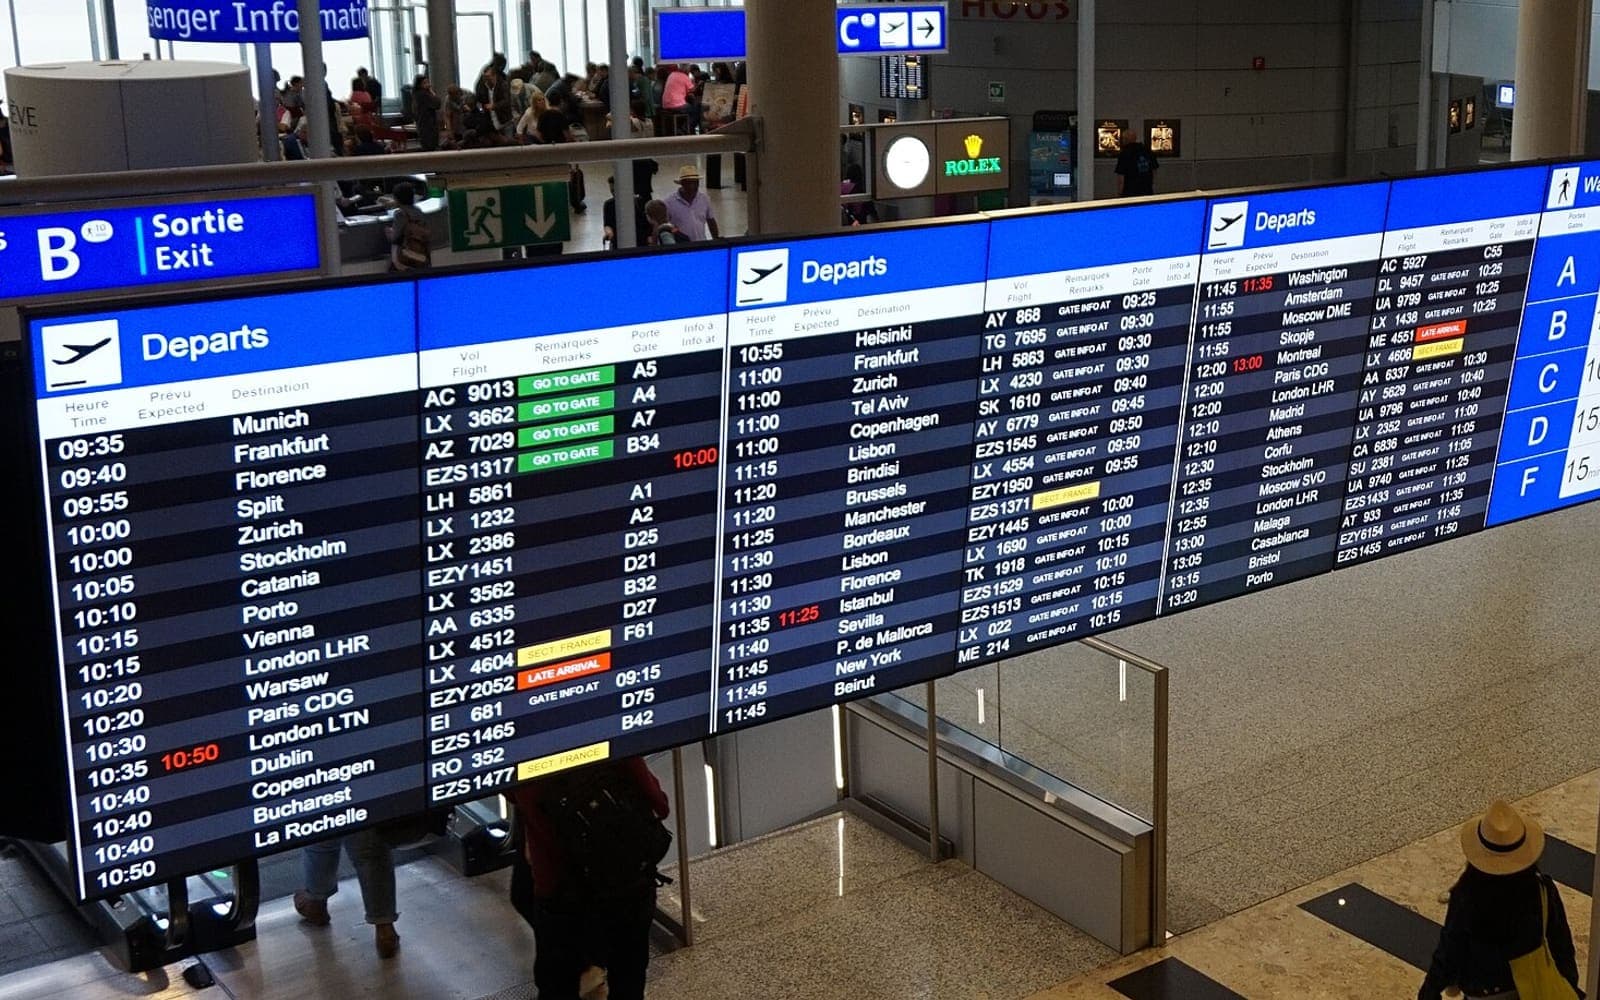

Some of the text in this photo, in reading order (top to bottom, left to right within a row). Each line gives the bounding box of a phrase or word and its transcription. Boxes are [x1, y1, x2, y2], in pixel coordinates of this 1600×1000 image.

[840, 15, 860, 47] C
[945, 157, 1001, 176] ROLEX
[152, 208, 244, 238] Sortie
[1255, 208, 1316, 233] Departs
[37, 227, 81, 281] B
[155, 243, 214, 271] Exit
[1483, 245, 1503, 259] C55
[801, 255, 887, 285] Departs
[1380, 255, 1428, 273] AC 5927
[1478, 262, 1503, 277] 10:25
[1556, 256, 1577, 287] A
[1207, 276, 1273, 298] 11:45 11:35
[1288, 268, 1348, 286] Washington
[1378, 274, 1425, 292] DL 9457
[1123, 292, 1156, 309] 09:25
[1284, 287, 1343, 306] Amsterdam
[857, 303, 911, 318] Destination
[985, 307, 1041, 328] AY 868
[1058, 304, 1081, 316] GATE
[631, 328, 660, 340] Porte
[856, 325, 912, 347] Helsinki
[1548, 310, 1568, 341] B
[142, 324, 270, 362] Departs
[534, 336, 600, 353] Remarques
[633, 342, 658, 353] Gate
[985, 328, 1047, 350] TG 7695
[460, 351, 480, 361] Vol
[542, 351, 592, 366] Remarks
[740, 343, 783, 363] 10:55
[854, 348, 919, 371] Frankfurt
[983, 350, 1044, 372] LH 5863
[1277, 345, 1322, 365] Montreal
[452, 364, 488, 378] Flight
[632, 360, 657, 379] A5
[739, 367, 782, 387] 11:00
[1197, 355, 1263, 378] 12:00 13:00
[1538, 362, 1559, 394] C
[231, 380, 309, 400] Destination
[533, 371, 601, 390] GO TO GATE
[852, 373, 897, 393] Zurich
[1114, 375, 1147, 393] 09:40
[424, 380, 515, 408] AC 9013
[632, 385, 656, 404] A4
[851, 394, 909, 416] Tel Aviv
[979, 393, 1041, 415] SK 1610
[65, 399, 110, 413] Heure
[137, 402, 205, 421] Expected
[1269, 403, 1305, 422] Madrid
[71, 414, 107, 428] Time
[233, 409, 309, 435] Munich
[425, 406, 515, 434] LX 3662
[631, 409, 656, 428] A7
[850, 413, 939, 439] Copenhagen
[1189, 420, 1219, 437] 12:10
[1528, 406, 1600, 446] D 15
[59, 434, 124, 460] 09:35
[234, 434, 329, 463] Frankfurt
[425, 431, 515, 460] AZ 7029
[627, 433, 660, 453] B34
[673, 447, 718, 469] 10:00
[1261, 457, 1313, 478] Stockholm
[61, 463, 126, 489] 09:40
[236, 464, 326, 490] Florence
[735, 460, 777, 481] 11:15
[847, 460, 899, 483] Brindisi
[1520, 456, 1591, 497] F 15
[427, 482, 512, 511] LH 5861
[846, 482, 907, 505] Brussels
[237, 495, 284, 519] Split
[630, 506, 653, 524] A2
[845, 501, 926, 527] Manchester
[67, 519, 130, 545] 10:00
[238, 519, 303, 545] Zurich
[427, 507, 514, 537] LX 1232
[625, 528, 658, 549] D25
[843, 525, 910, 549] Bordeaux
[1252, 528, 1309, 551] Casablanca
[240, 540, 346, 571] Stockholm
[1246, 571, 1273, 587] Porto
[840, 588, 894, 613] Istanbul
[1168, 589, 1198, 608] 13:20
[75, 602, 136, 628] 10:10
[428, 604, 515, 636] AA 6335
[729, 605, 819, 638] 11:35 11:25
[838, 613, 884, 634] Sevilla
[1089, 610, 1120, 628] 10:15
[624, 621, 653, 641] F61
[560, 635, 602, 652] FRANCE
[245, 635, 370, 676] London LHR
[835, 648, 901, 676] New York
[528, 659, 600, 684] LATE ARRIVAL
[615, 664, 662, 688] 09:15
[81, 682, 142, 709] 10:20
[246, 672, 329, 700] Warsaw
[834, 674, 875, 696] Beirut
[248, 688, 354, 726] Paris CDG
[431, 701, 502, 732] EI 681
[726, 702, 766, 723] 11:45
[249, 709, 369, 751] London LTN
[622, 710, 653, 730] B42
[88, 743, 220, 787] 10:35 10:50
[251, 749, 313, 776] Dublin
[432, 747, 504, 778] RO 352
[252, 759, 375, 799] Copenhagen
[253, 786, 352, 824] Bucharest
[255, 808, 367, 848] La Rochelle
[97, 860, 156, 886] 10:50
